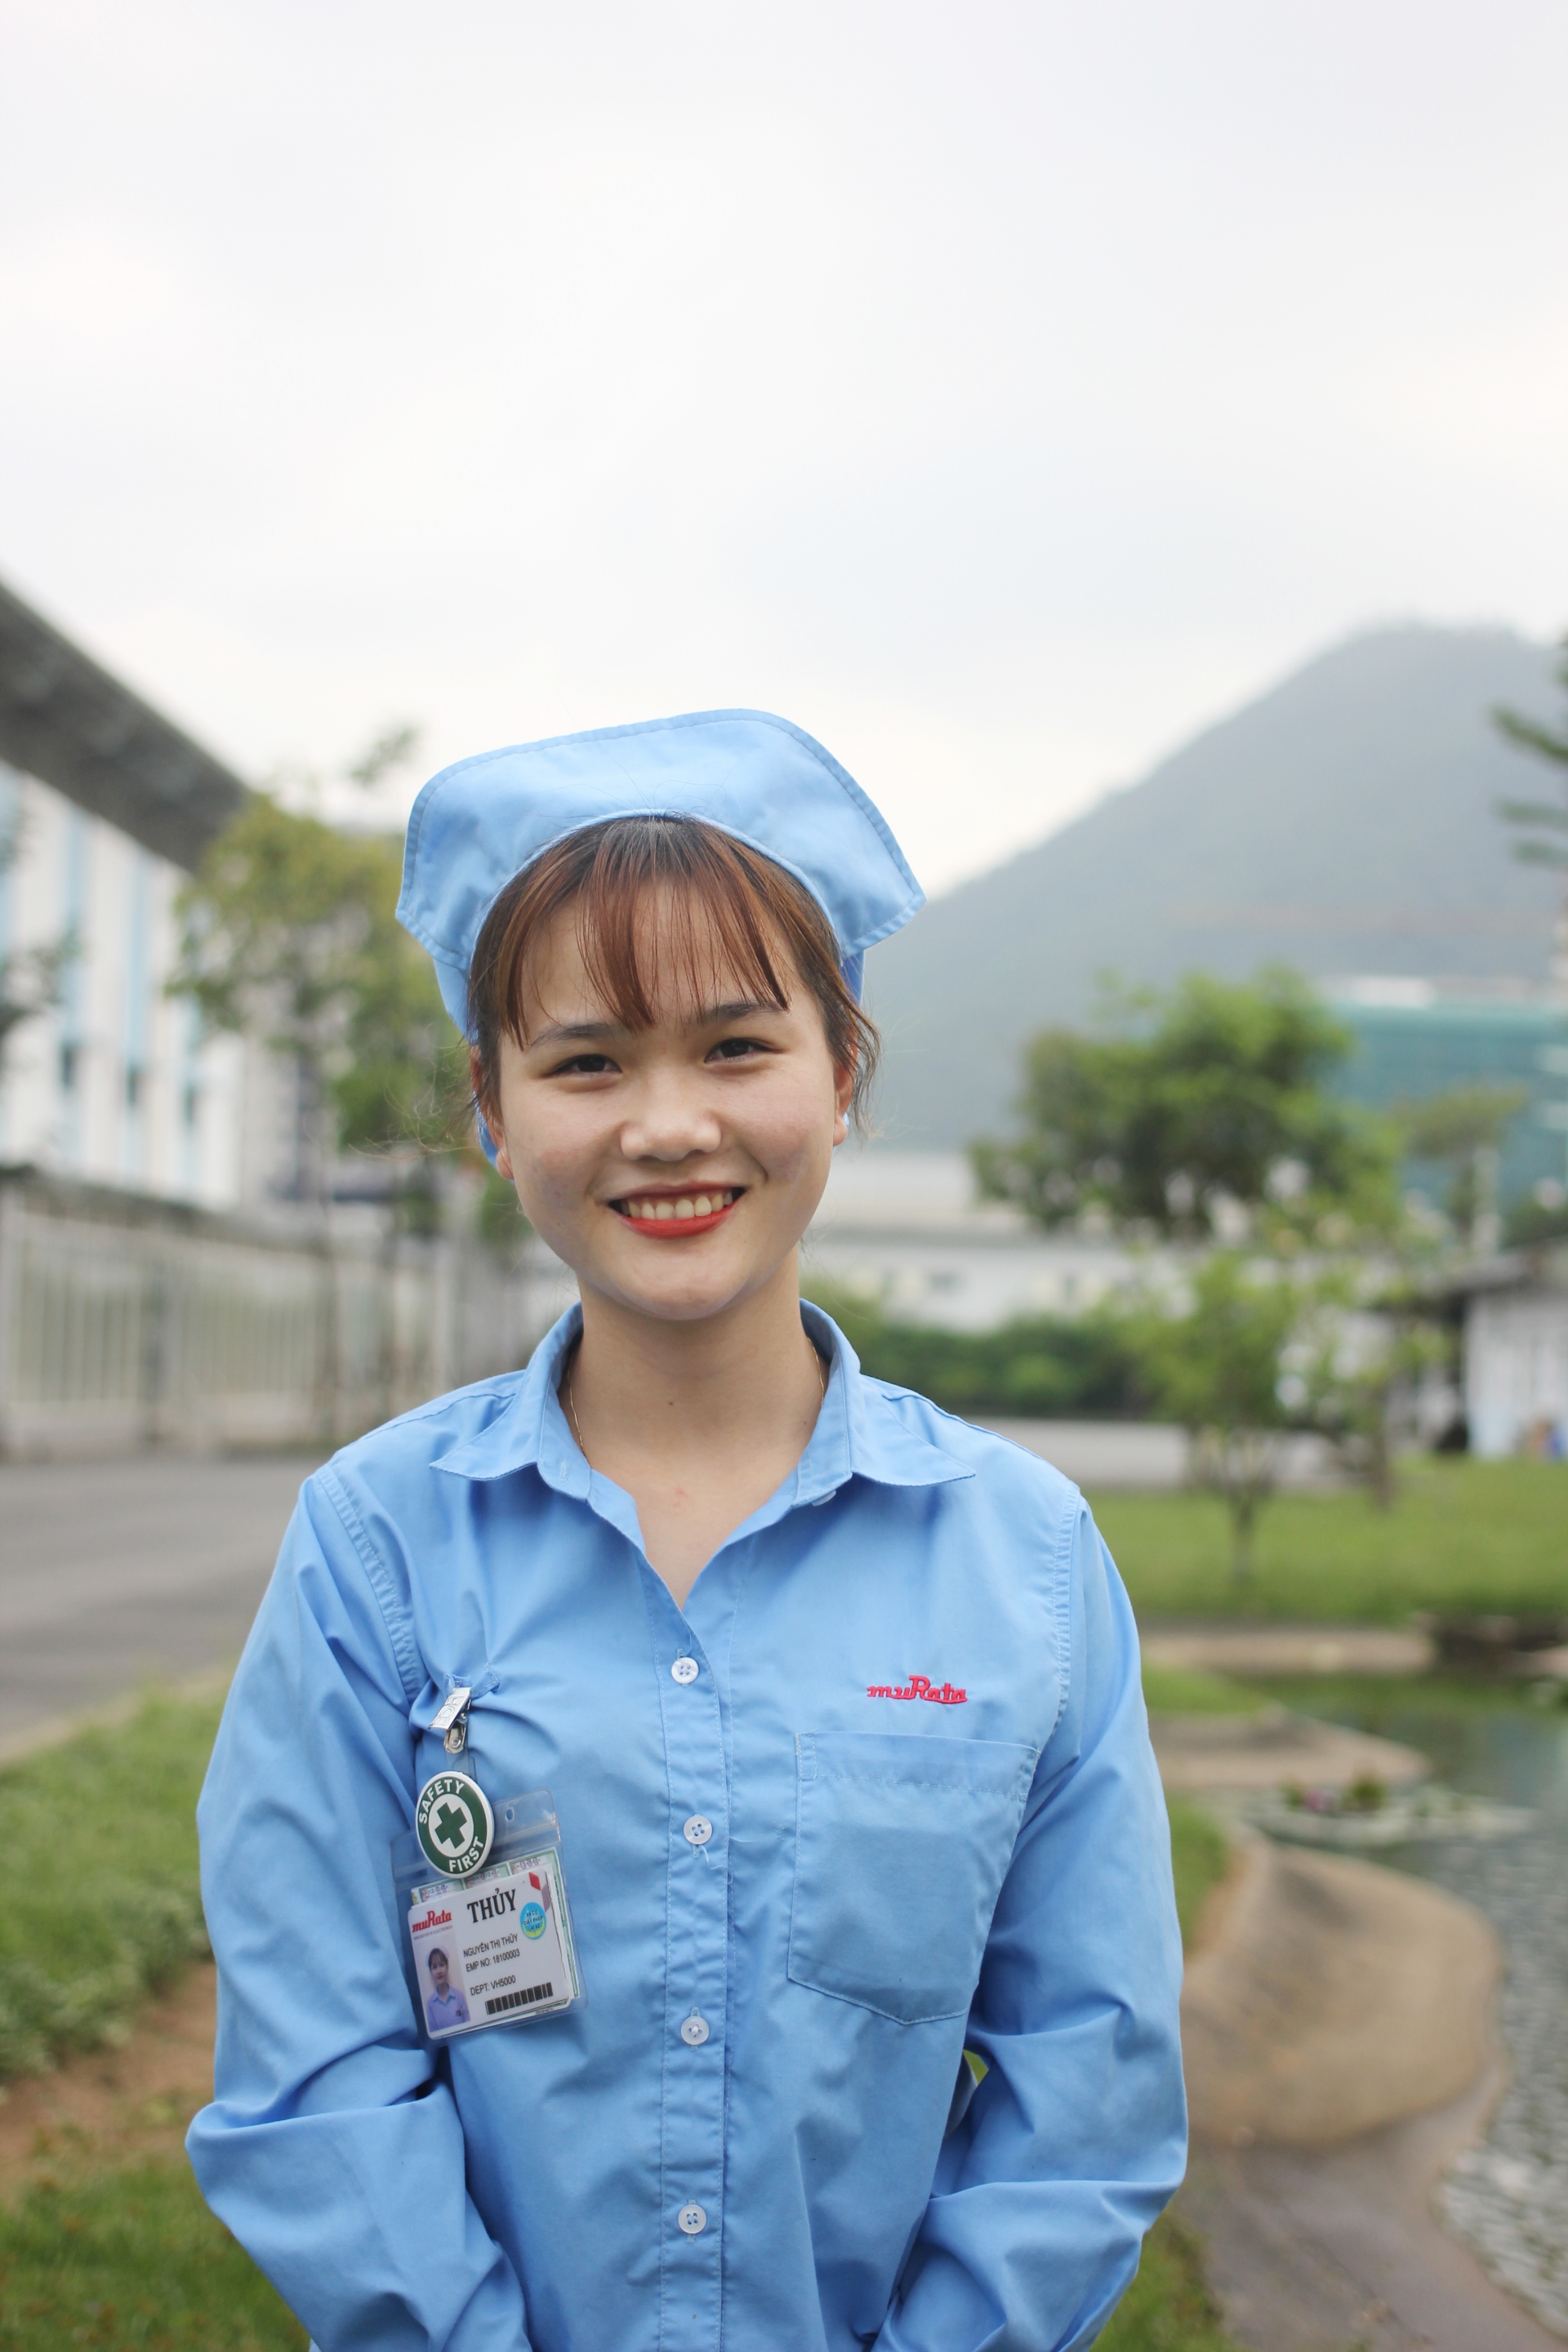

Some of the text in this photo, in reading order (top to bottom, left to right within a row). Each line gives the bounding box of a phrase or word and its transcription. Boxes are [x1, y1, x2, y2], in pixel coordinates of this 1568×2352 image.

[866, 1674, 968, 1704] muRata
[419, 1779, 465, 1824] SAFETY
[449, 1836, 483, 1873] FIRST
[466, 1887, 516, 1923] THỦY
[412, 1909, 452, 1932] muRata
[490, 1939, 501, 1949] THỊ
[466, 1949, 520, 1972] EMP NO: 18100003
[470, 1975, 516, 1996] DEPT: VH5000
